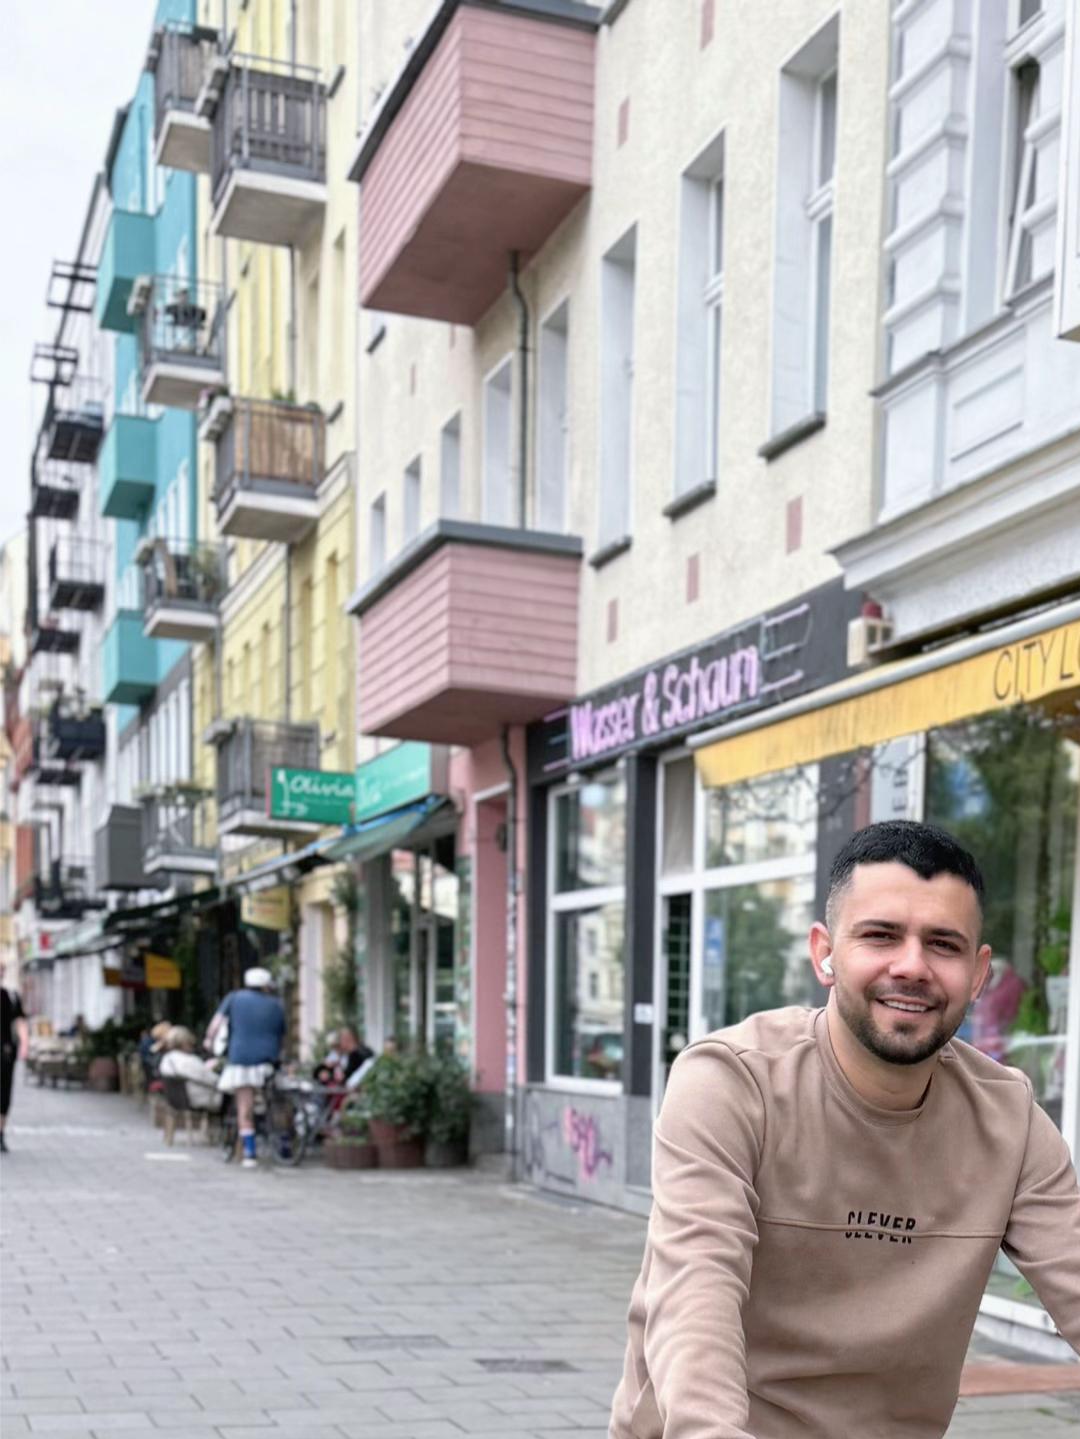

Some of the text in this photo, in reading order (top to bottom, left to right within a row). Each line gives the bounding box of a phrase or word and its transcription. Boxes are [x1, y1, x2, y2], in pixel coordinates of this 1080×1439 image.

[993, 633, 1056, 701] CITY
[570, 645, 759, 761] Wasser & Schaum
[845, 1211, 916, 1244] CLEVER
